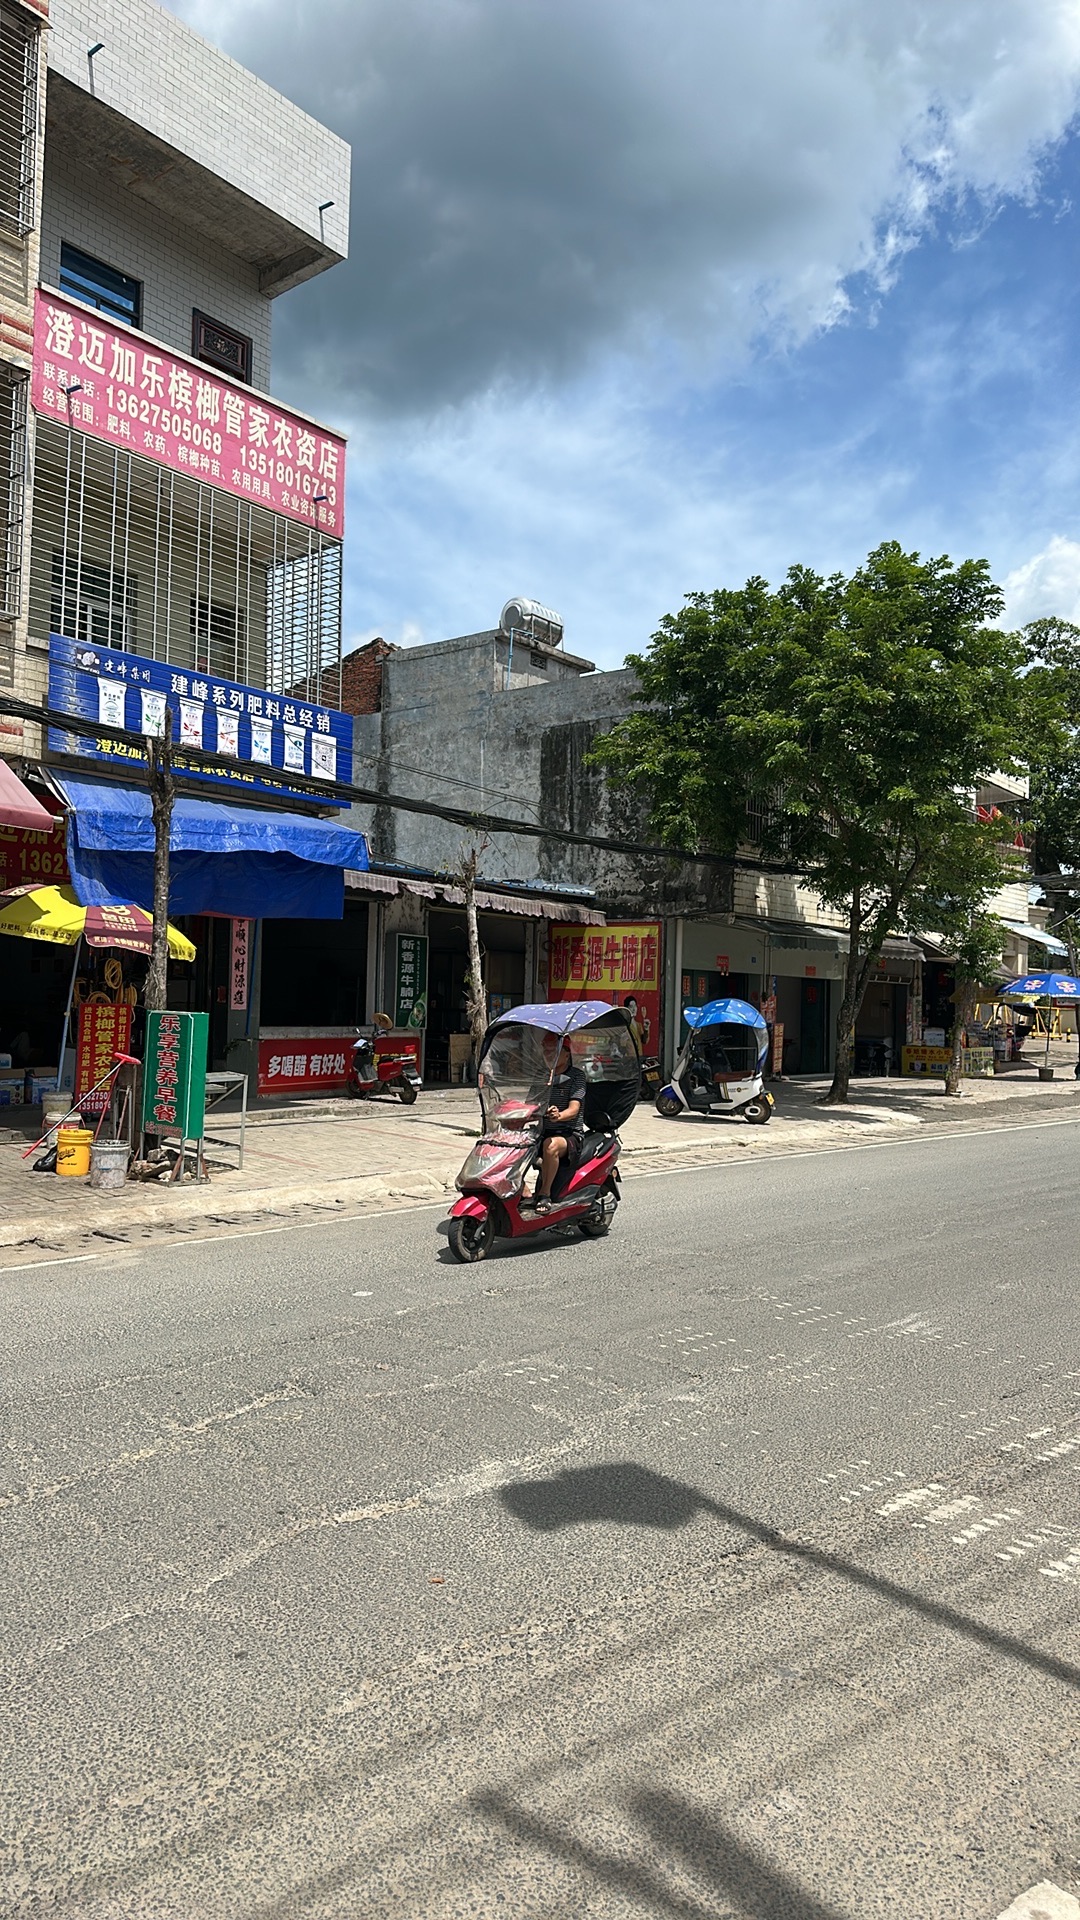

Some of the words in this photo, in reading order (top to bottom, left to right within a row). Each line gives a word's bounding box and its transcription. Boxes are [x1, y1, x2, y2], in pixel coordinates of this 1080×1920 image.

[44, 305, 339, 483] 澄迈加乐槟榔管家农资店
[106, 385, 222, 455] 13627505068
[240, 445, 337, 507] 13518016713
[171, 673, 331, 733] 建峰系列肥料总经销
[400, 939, 415, 1009] 新香源牛腩店
[553, 934, 657, 983] 新香源牛腩店
[153, 1014, 181, 1123] 乐享营养早餐
[267, 1054, 308, 1078] 多喝醋
[309, 1053, 346, 1077] 有好处
